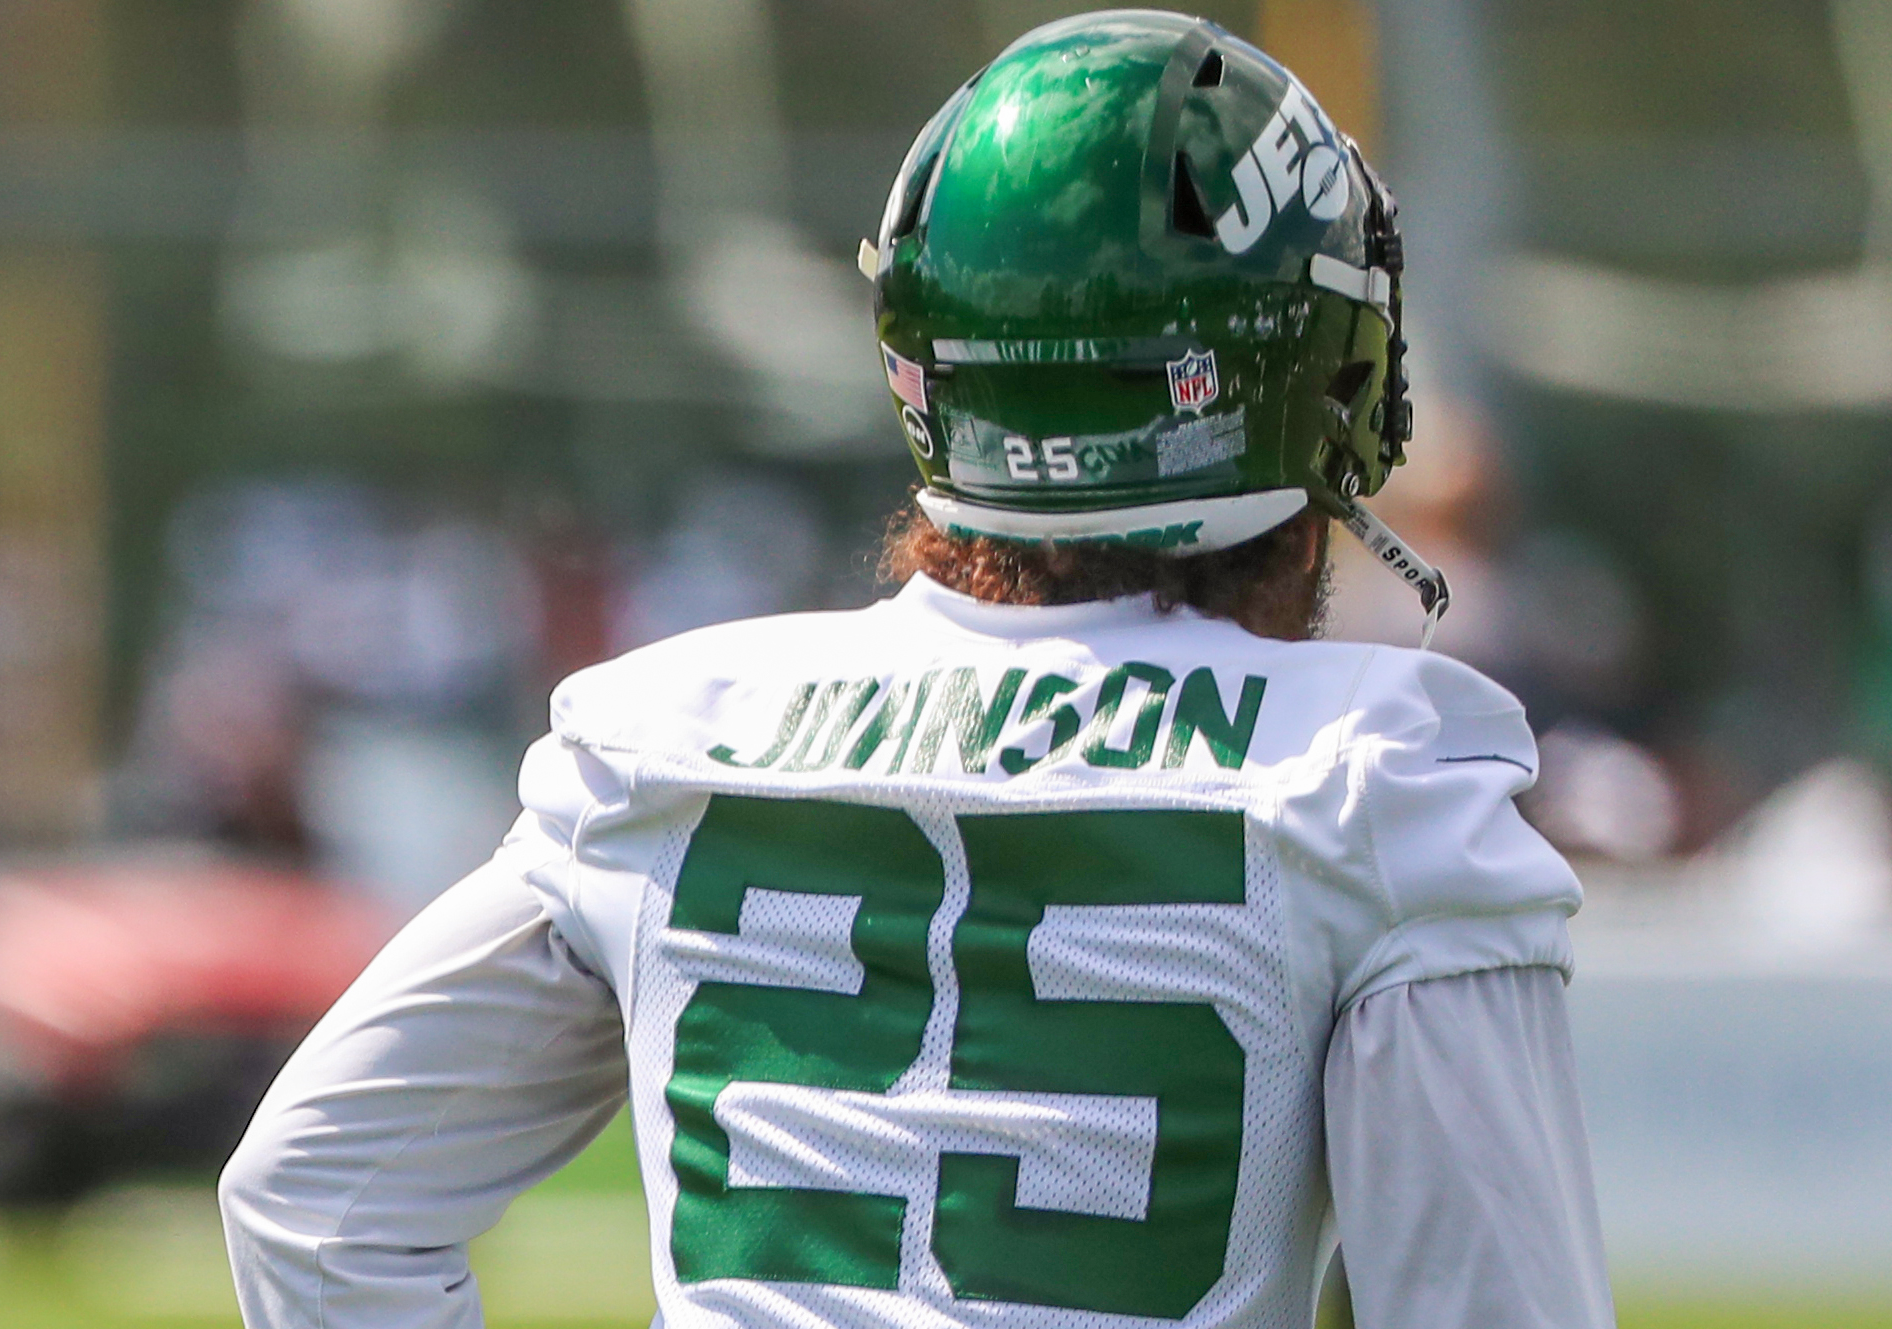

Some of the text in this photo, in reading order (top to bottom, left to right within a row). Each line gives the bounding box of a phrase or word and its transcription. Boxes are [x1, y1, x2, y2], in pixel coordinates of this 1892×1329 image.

[1175, 375, 1213, 405] NFL
[1003, 435, 1079, 481] 25
[708, 661, 1268, 775] JOHNSON
[666, 794, 1248, 1322] 25
